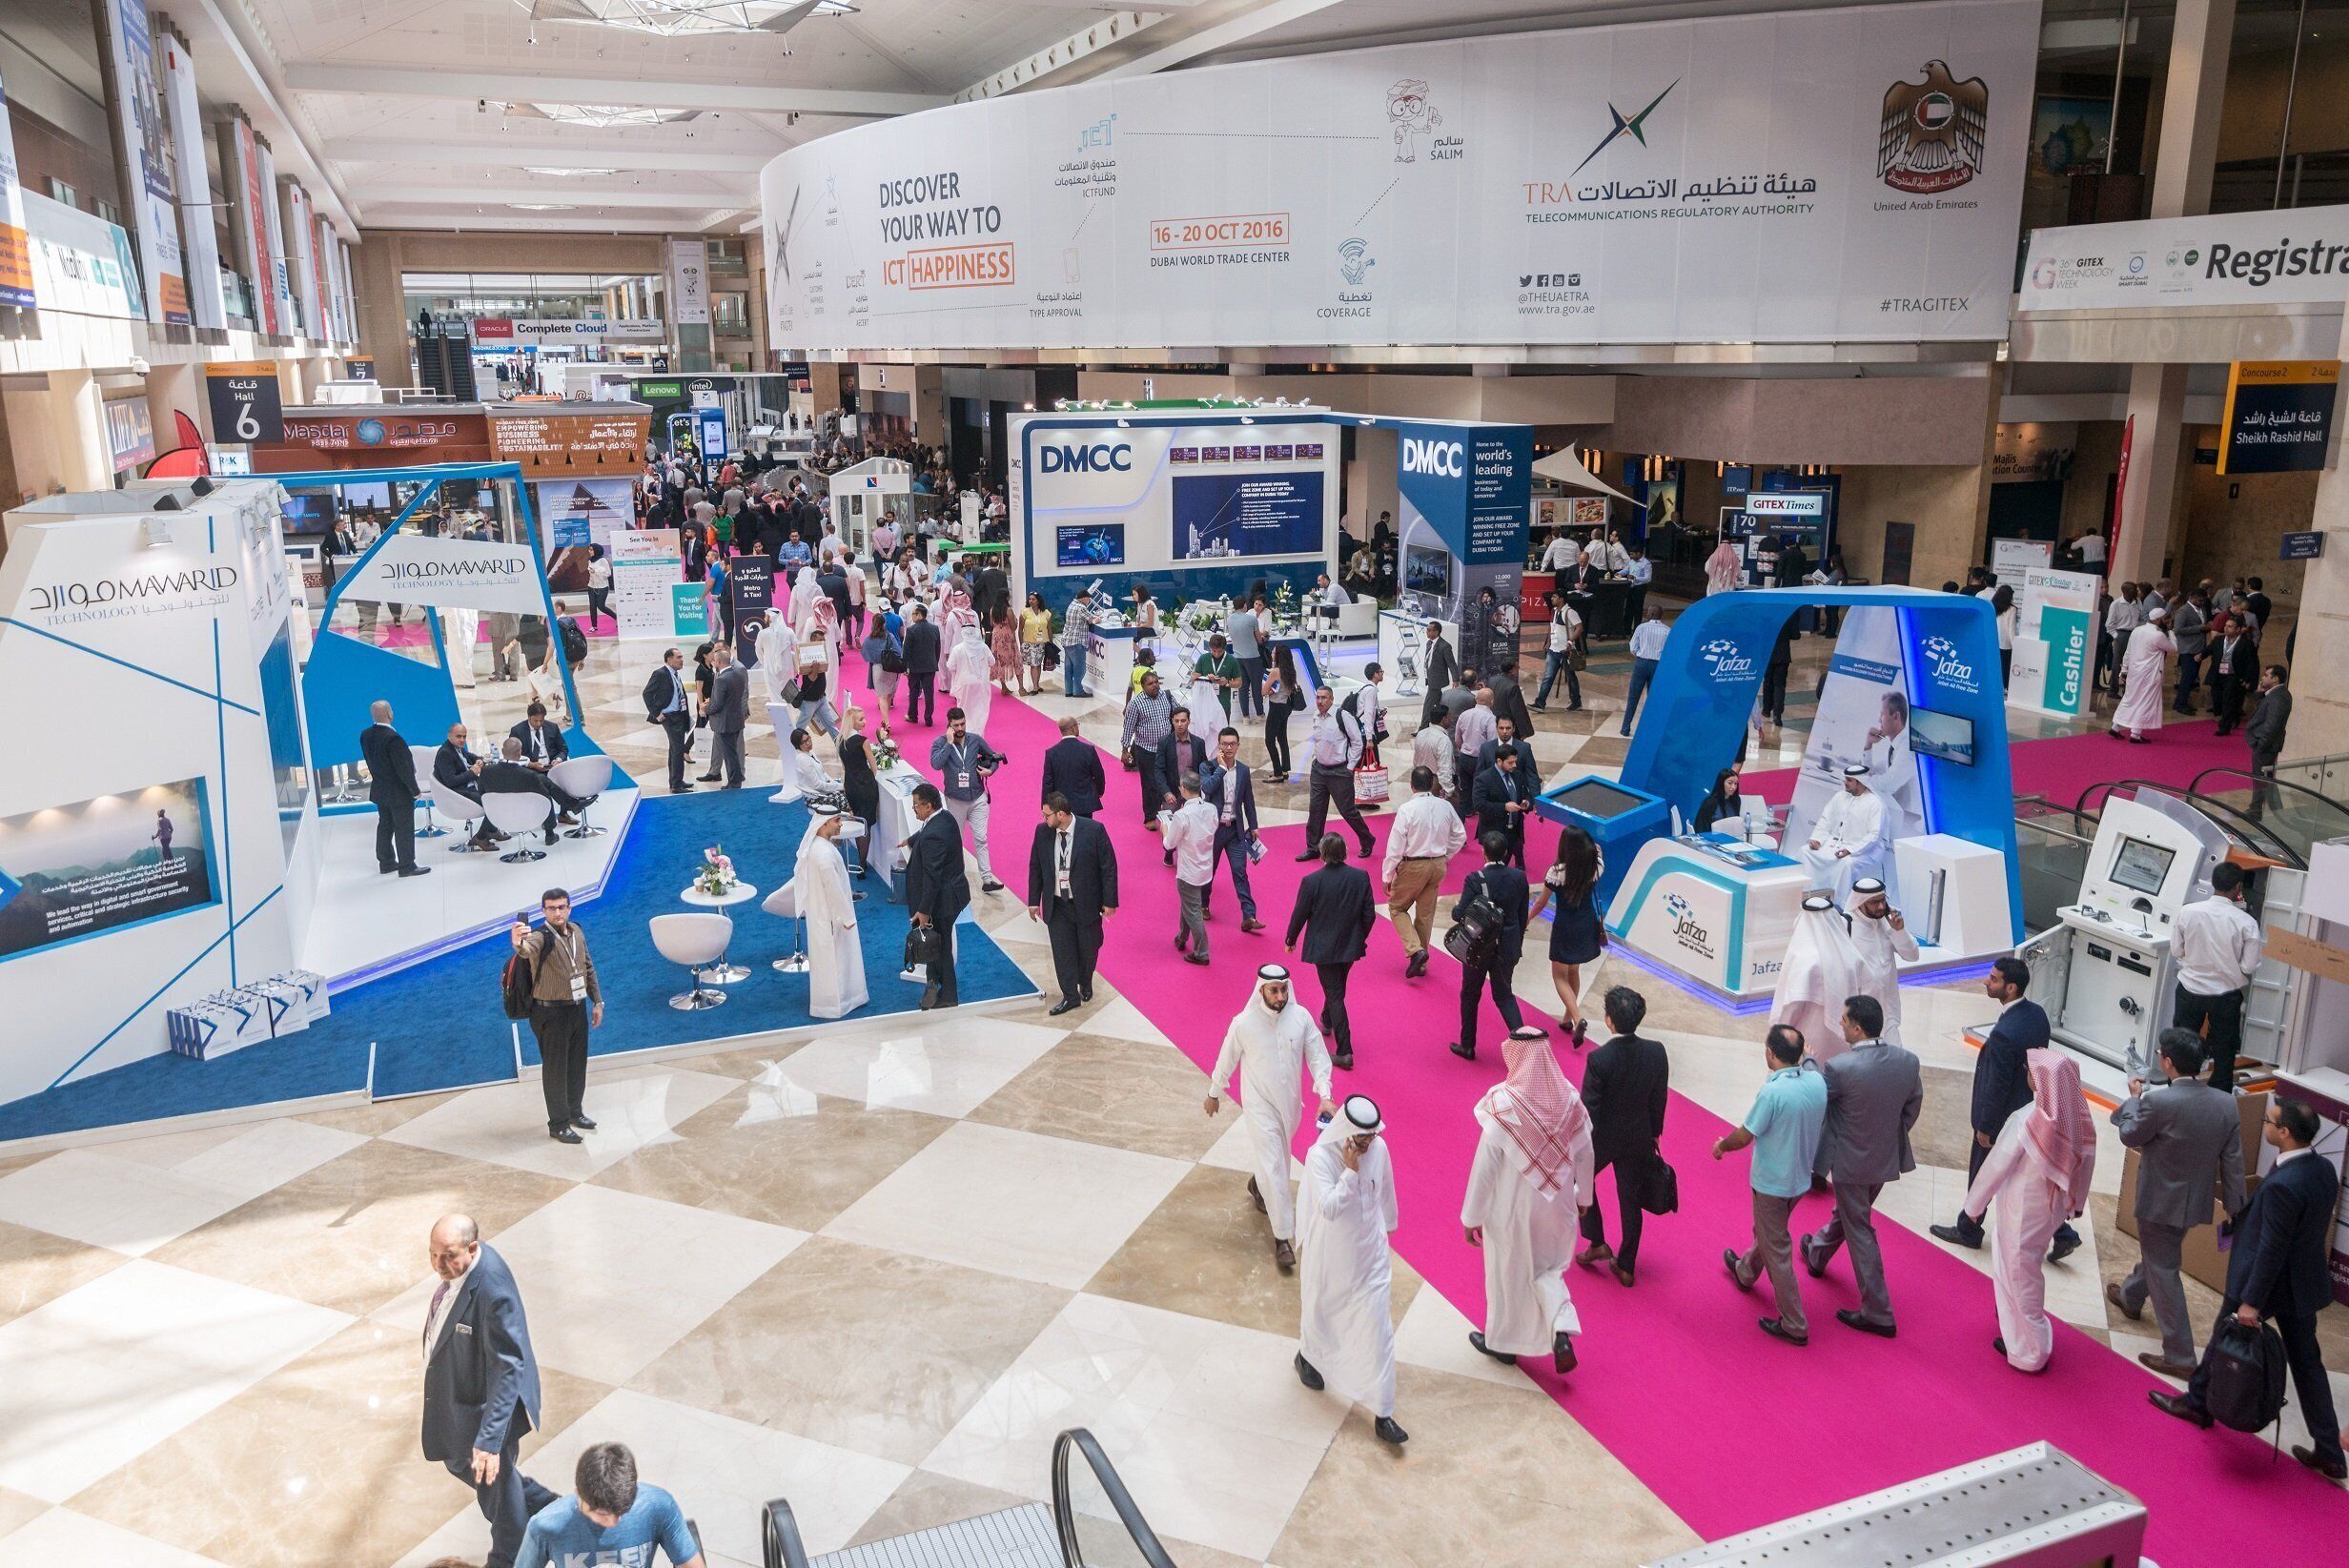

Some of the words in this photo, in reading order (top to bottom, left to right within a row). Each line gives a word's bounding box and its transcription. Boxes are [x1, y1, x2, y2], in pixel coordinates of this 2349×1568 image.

[1434, 135, 1463, 150] سالم
[1430, 149, 1463, 161] SALIM
[1058, 161, 1089, 172] الاتصالات
[1091, 159, 1115, 172] صندوق
[1054, 175, 1091, 187] المعلومات
[1764, 173, 1816, 199] هيئة
[880, 172, 961, 208] DISCOVER
[1083, 187, 1115, 198] ICTFUND
[1522, 182, 1573, 204] TRA
[1578, 178, 1677, 202] الاتصالات
[1682, 175, 1757, 202] تنظيم
[1873, 201, 1907, 212] United
[1910, 200, 1933, 210] Arab
[1936, 200, 1978, 210] Emirates
[1525, 209, 1658, 223] TELECOMMUNICATIONS
[1661, 206, 1740, 218] REGULATORY
[1742, 204, 1814, 216] AUTHORITY
[881, 214, 924, 243] YOUR
[927, 208, 969, 238] WAY
[972, 205, 1001, 234] TO
[1154, 227, 1171, 243] 16
[1182, 225, 1201, 242] 20
[1205, 223, 1239, 241] OCT
[1242, 220, 1283, 239] 2016
[1151, 256, 1178, 267] DUBAI
[1179, 255, 1215, 266] WORLD
[1216, 254, 1248, 265] TRADE
[1251, 252, 1290, 263] CENTER
[2076, 257, 2104, 268] GITEX
[884, 259, 906, 285] ICT
[911, 251, 1011, 283] HAPPINESS
[2058, 268, 2114, 278] TECHNOLOGY
[1036, 293, 1060, 303] النوعية
[1338, 292, 1372, 305] تغطية
[1518, 292, 1589, 304] @THEUAETRA
[1880, 297, 1970, 312] #TRAGITEX
[1030, 309, 1046, 317] TYPE
[1046, 308, 1082, 317] APPROVAL
[1317, 307, 1372, 318] COVERAGE
[1518, 305, 1595, 316] www.tra.gov.ae
[518, 323, 572, 335] Complete
[575, 323, 607, 333] Cloud
[356, 371, 366, 379] 7
[2241, 368, 2281, 377] Concourse
[2282, 367, 2288, 377] 2
[2312, 367, 2317, 377] 2
[229, 379, 257, 389] قاعة
[691, 381, 710, 390] intel
[235, 393, 255, 401] Hall
[236, 403, 260, 439] 6
[2243, 411, 2265, 425] راشد
[2267, 410, 2296, 427] الشيخ
[2298, 411, 2321, 422] قاعة
[284, 423, 349, 439] Masdar
[392, 422, 458, 438] مصدر
[2237, 432, 2268, 444] Sheikh
[2270, 431, 2301, 443] Rashid
[2303, 430, 2322, 441] Hall
[1040, 443, 1132, 473] DMCC
[1403, 438, 1463, 478] DMCC
[1476, 449, 1512, 460] world's
[1993, 454, 2016, 463] Majlis
[1475, 464, 1513, 477] leading
[1740, 516, 1757, 527] 70
[440, 558, 525, 575] MAWARID
[119, 566, 237, 600] MAWARID
[391, 579, 454, 589] TECHNOLOGY
[2029, 575, 2044, 586] GITEX
[44, 604, 139, 626] TECHNOLOGY
[1710, 656, 1751, 676] Jafza
[1932, 656, 1971, 679] Jafza
[2060, 625, 2084, 706] Cashier
[56, 907, 70, 916] lead
[100, 896, 118, 906] digital
[130, 888, 147, 897] smart
[147, 881, 179, 894] government
[47, 914, 73, 926] services,
[73, 909, 94, 919] critical
[106, 900, 131, 911] strategic
[131, 891, 167, 905] infrastructure
[167, 886, 190, 896] security
[61, 917, 93, 930] automation
[1673, 916, 1707, 942] Jafza
[1751, 962, 1783, 975] Jafza
